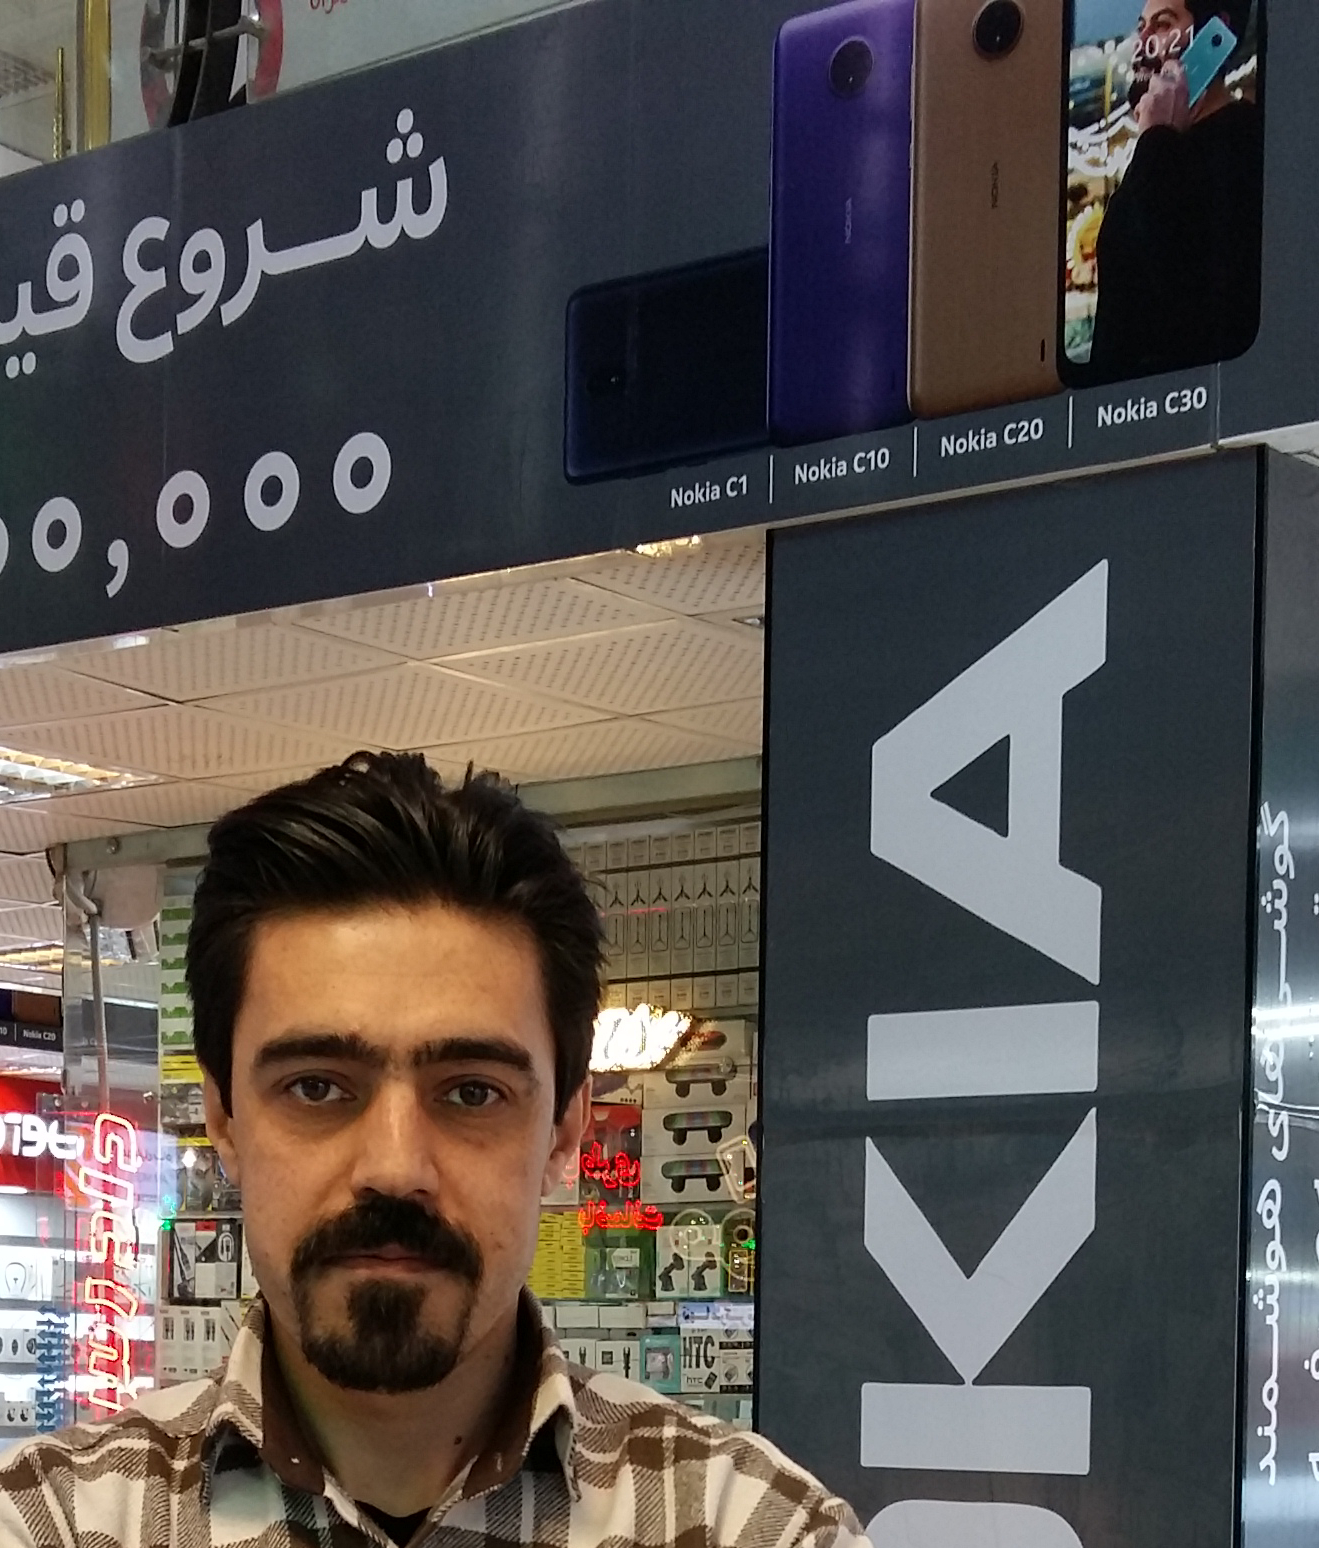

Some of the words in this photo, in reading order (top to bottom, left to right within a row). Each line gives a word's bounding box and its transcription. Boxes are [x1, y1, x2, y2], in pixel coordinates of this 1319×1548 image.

[117, 108, 448, 363] شروع
[1096, 400, 1159, 428] Nokia
[1164, 386, 1207, 414] C30
[940, 429, 998, 458] Nokia
[1002, 417, 1044, 446] C20
[793, 456, 848, 485] Nokia
[852, 446, 890, 474] C10
[670, 481, 720, 508] Nokia
[726, 474, 749, 498] C1
[23, 1028, 42, 1039] Nokia
[42, 1031, 56, 1042] C20
[683, 1335, 716, 1370] HTC
[1252, 1179, 1287, 1487] هوشمند
